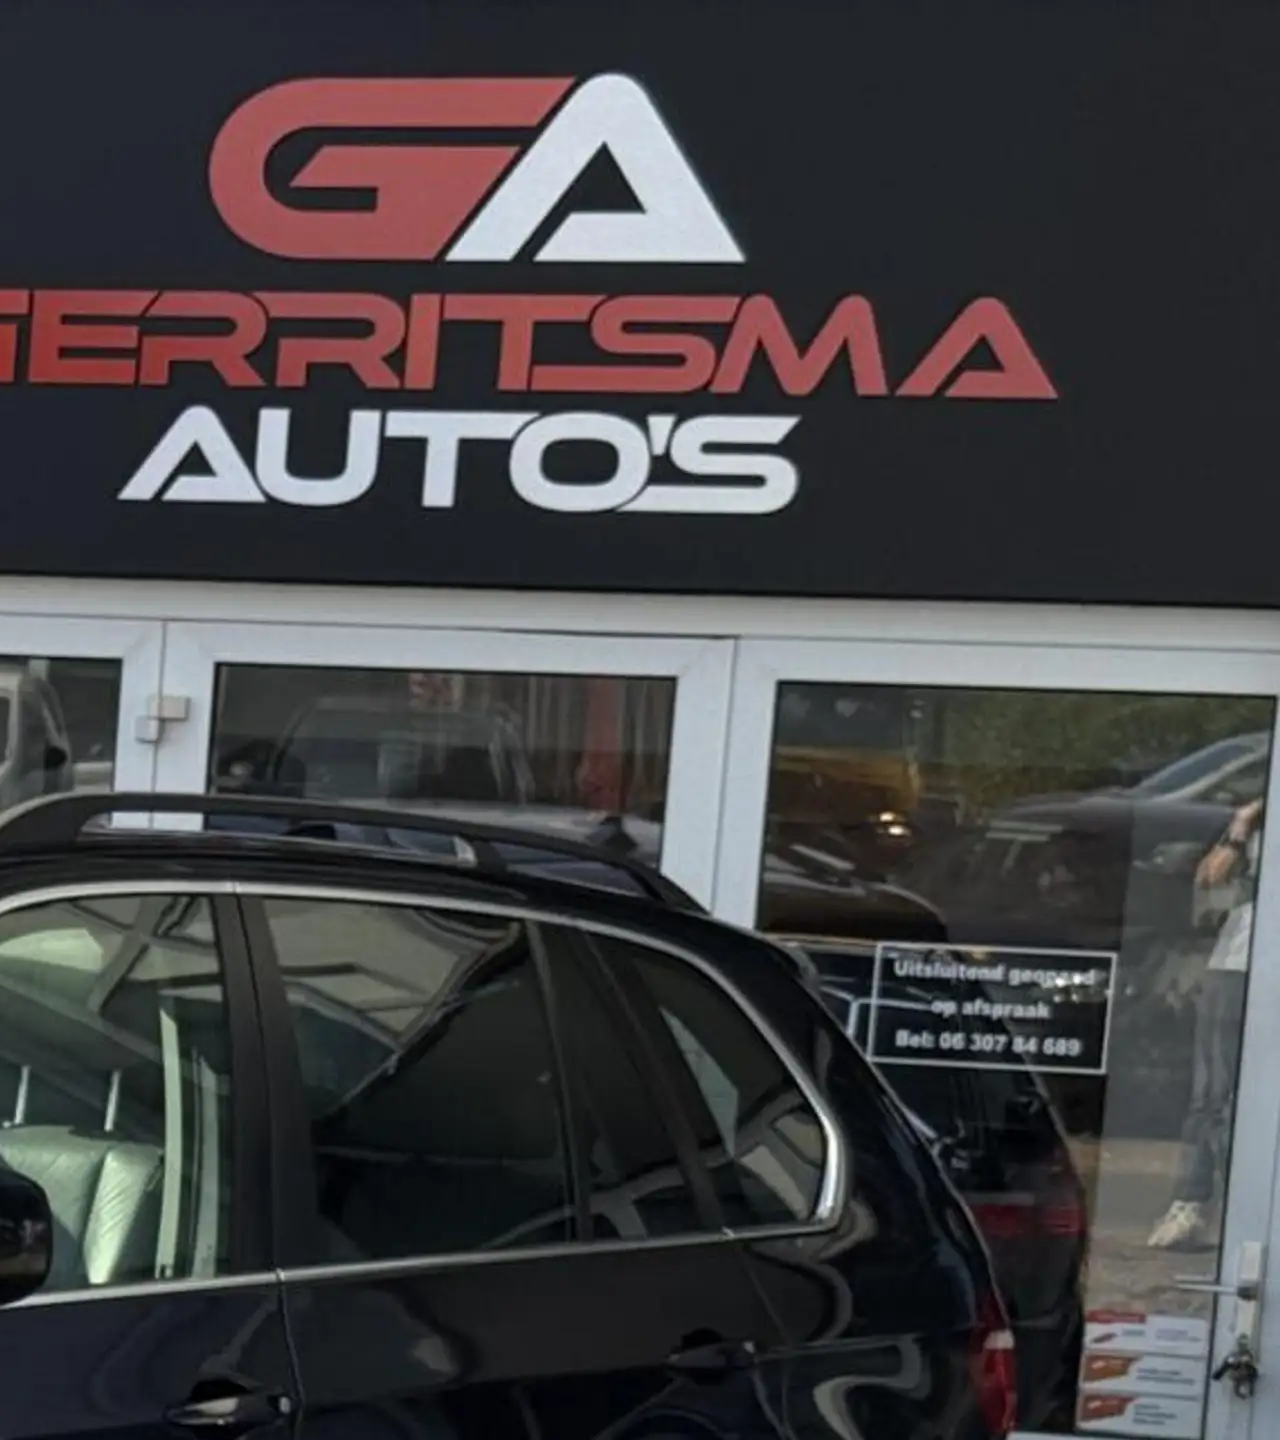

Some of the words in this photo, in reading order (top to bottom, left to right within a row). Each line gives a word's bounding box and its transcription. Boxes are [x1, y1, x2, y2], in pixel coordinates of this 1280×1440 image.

[117, 404, 801, 515] AUTO'S
[893, 959, 1004, 982] Uitsluitend
[930, 999, 957, 1018] op
[961, 998, 1051, 1020] afspraak
[938, 1030, 966, 1050] 06
[969, 1033, 1009, 1053] 307
[1011, 1036, 1037, 1055] 84
